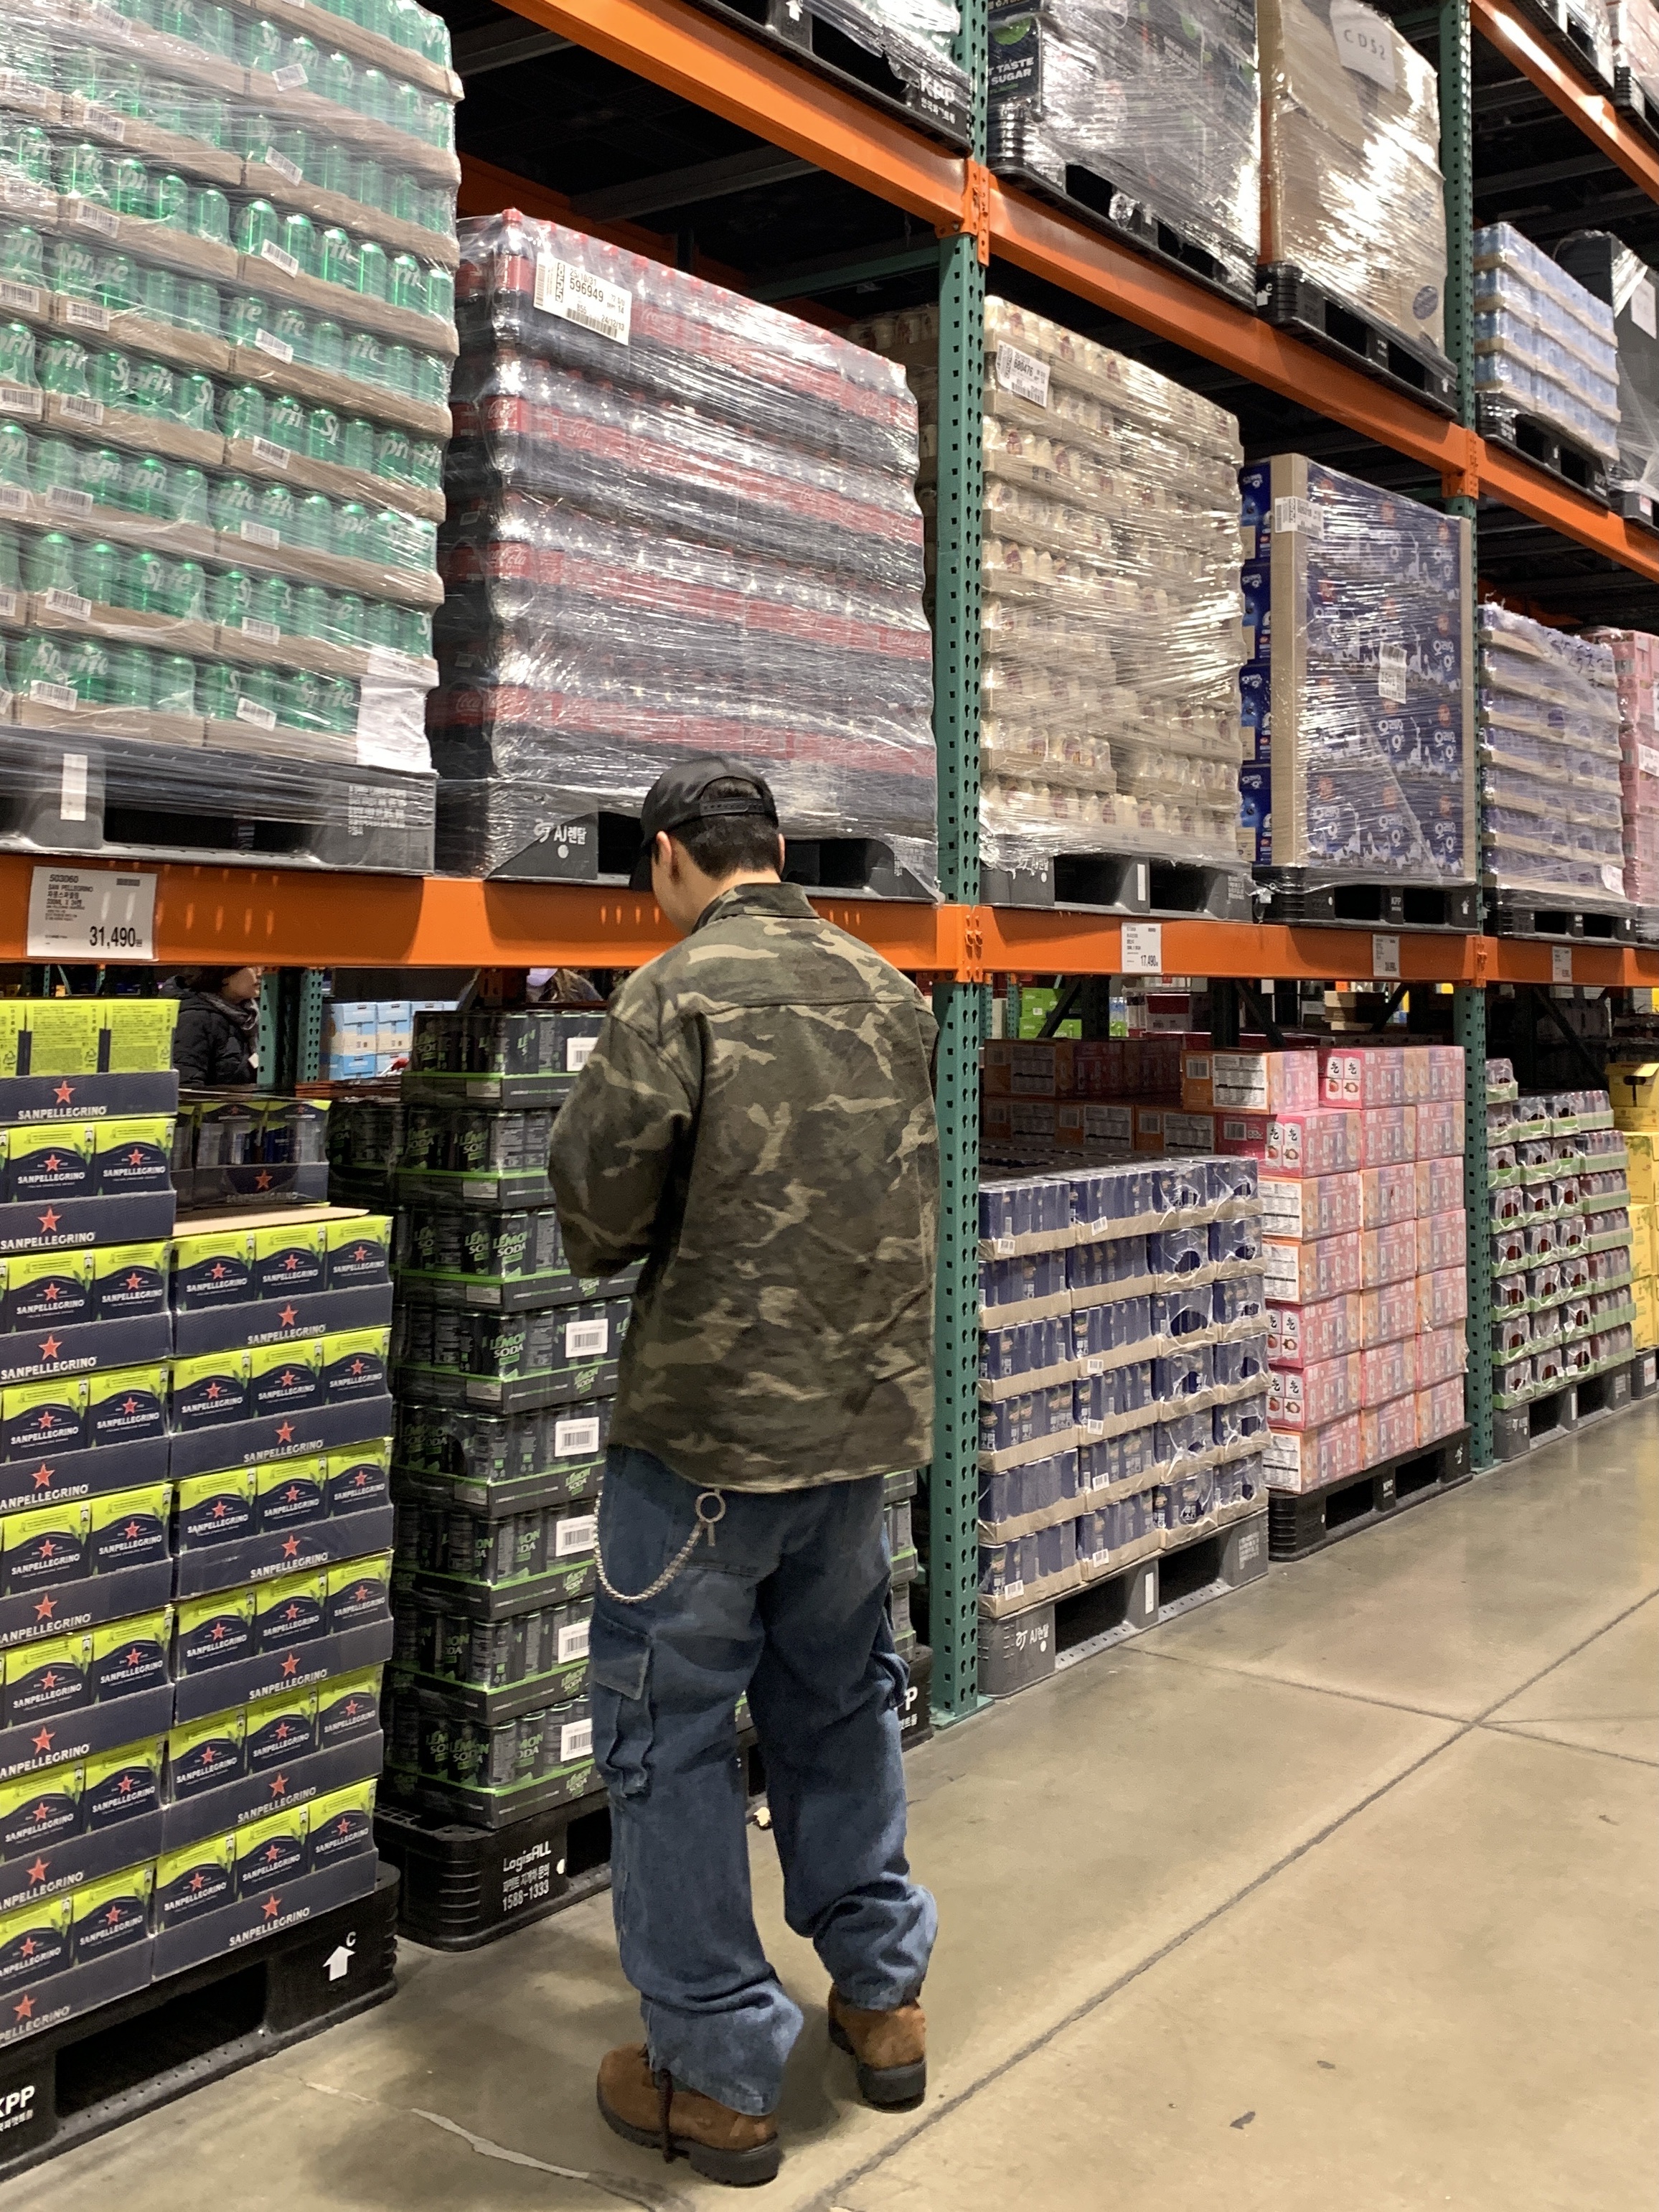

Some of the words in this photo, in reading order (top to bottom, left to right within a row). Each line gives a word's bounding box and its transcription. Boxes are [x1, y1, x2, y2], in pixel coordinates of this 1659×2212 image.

[996, 57, 1034, 72] TASTE
[992, 68, 1032, 85] SUGAR
[570, 268, 597, 286] 25/10/31
[570, 277, 604, 303] 596949
[553, 825, 588, 845] AJ렌탈
[18, 1106, 107, 1120] SANPELLEGRINO
[18, 1171, 85, 1185] SANPELLEGRINO
[103, 1166, 166, 1178] SANPELLEGRINO
[1, 1232, 96, 1250] SANPELLEGRINO
[497, 1242, 527, 1257] SODA
[263, 1268, 319, 1283] SANPELLEGRINO
[333, 1260, 385, 1274] SANPELLEGRINO
[102, 1289, 163, 1303] SANPELLEGRINO
[186, 1278, 248, 1293] SANPELLEGRINO
[16, 1299, 85, 1316] SANPELLEGRINO
[247, 1323, 326, 1345] SANPELLEGRINO
[493, 1343, 525, 1359] SODA
[1, 1356, 98, 1380] SANPELLEGRINO
[329, 1372, 383, 1389] SANPELLEGRINO
[258, 1384, 316, 1401] SANPELLEGRINO
[181, 1396, 243, 1414] SANPELLEGRINO
[96, 1411, 160, 1430] SANPELLEGRINO
[10, 1426, 80, 1445] SANPELLEGRINO
[244, 1439, 324, 1463] SANPELLEGRINO
[0, 1484, 89, 1510] ANPELLEGRINO
[334, 1482, 385, 1501] SANPELLEGRINO
[263, 1497, 320, 1518] SANPELLEGRINO
[187, 1513, 249, 1534] SANPELLEGRINO
[98, 1534, 163, 1555] SANPELLEGRINO
[11, 1553, 81, 1575] SANPELLEGRINO
[250, 1552, 329, 1579] SANPELLEGRINO
[334, 1595, 386, 1618] SANPELLEGRINO
[0, 1613, 92, 1644] ANPELLEGRINO
[263, 1614, 320, 1637] SANPELLEGRINO
[187, 1634, 248, 1658] SANPELLEGRINO
[100, 1659, 164, 1684] SANPELLEGRINO
[12, 1682, 83, 1709] SANPELLEGRINO
[249, 1669, 329, 1701] SANPELLEGRINO
[324, 1710, 377, 1734] SANPELLEGRINO
[253, 1733, 310, 1758] SANPELLEGRINO
[0, 1743, 90, 1779] ANPELLEGRINO
[176, 1757, 238, 1785] SANPELLEGRINO
[92, 1786, 156, 1814] SANPELLEGRINO
[237, 1786, 317, 1824] SANPELLEGRINO
[4, 1813, 75, 1843] SANPELLEGRINO
[315, 1827, 369, 1855] SANPELLEGRINO
[242, 1853, 301, 1882] SANPELLEGRINO
[503, 1841, 551, 1873] LogisALL
[0, 1871, 85, 1911] NPELLEGRINO
[164, 1881, 227, 1911] SANPELLEGRINO
[503, 1879, 550, 1912] 1588-1333
[79, 1915, 144, 1946] SANPELLEGRINO
[229, 1907, 311, 1947] SANPELLEGRINO
[346, 1931, 357, 1948] C
[0, 1946, 62, 1977] ANPELLEGRINO
[0, 2006, 70, 2041] PELLEGRINO
